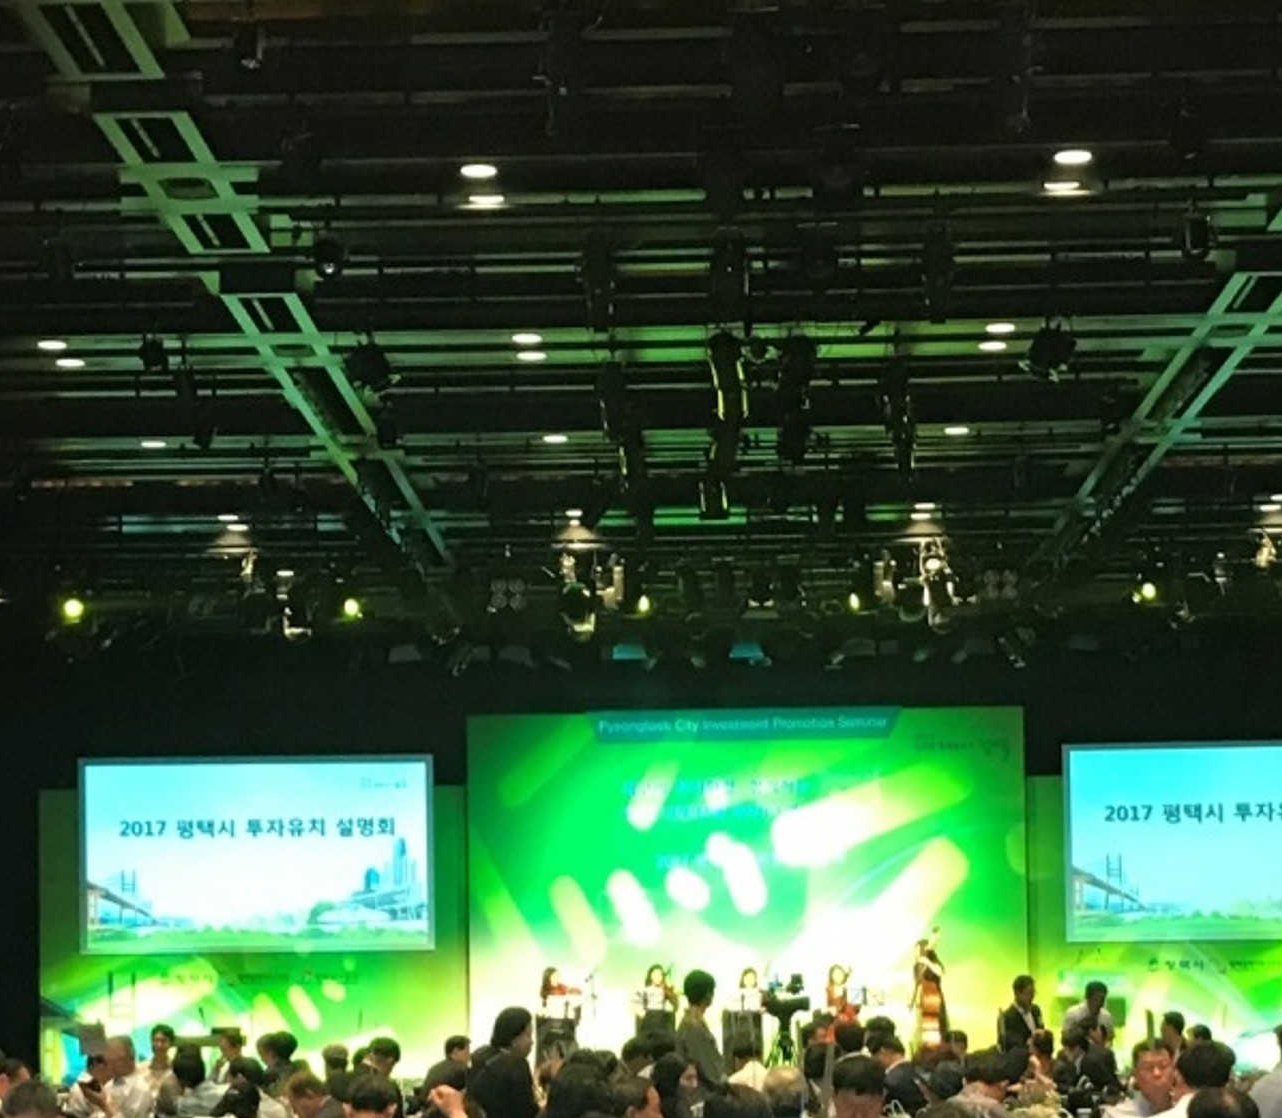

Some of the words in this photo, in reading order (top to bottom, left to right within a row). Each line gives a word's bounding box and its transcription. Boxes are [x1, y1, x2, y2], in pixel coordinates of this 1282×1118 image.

[674, 718, 699, 733] City
[702, 718, 769, 732] Investment
[772, 716, 835, 730] Promotion
[837, 715, 888, 729] Seminar
[1103, 804, 1153, 823] 2017
[1161, 802, 1225, 825] 평택시
[119, 819, 167, 838] 2017
[175, 818, 237, 840] 평택시
[245, 818, 327, 838] 투자유치
[335, 816, 396, 838] 설명회
